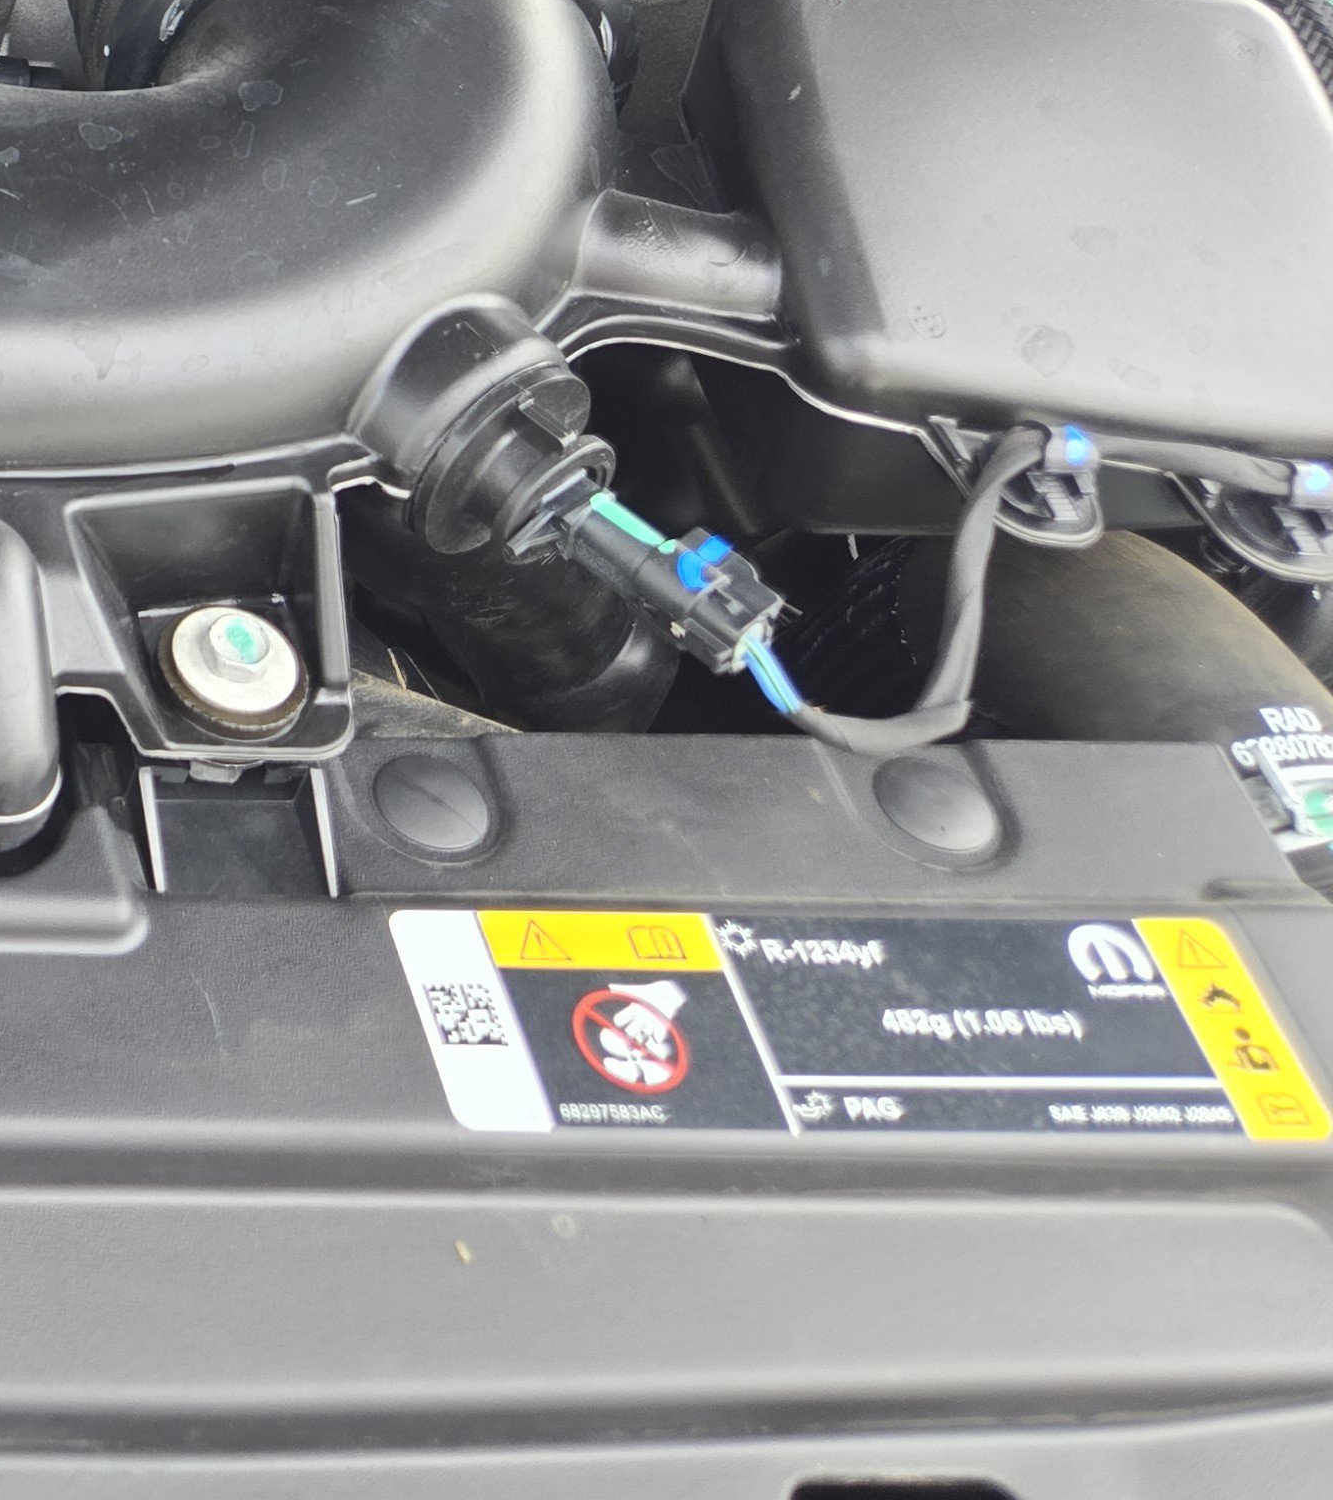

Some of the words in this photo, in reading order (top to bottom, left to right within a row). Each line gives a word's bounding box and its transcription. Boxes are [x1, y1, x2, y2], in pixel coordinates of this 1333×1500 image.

[1259, 706, 1323, 733] RAD
[760, 938, 886, 970] R-1234yf
[1026, 1007, 1084, 1042] lbs)
[842, 1097, 905, 1122] PAG
